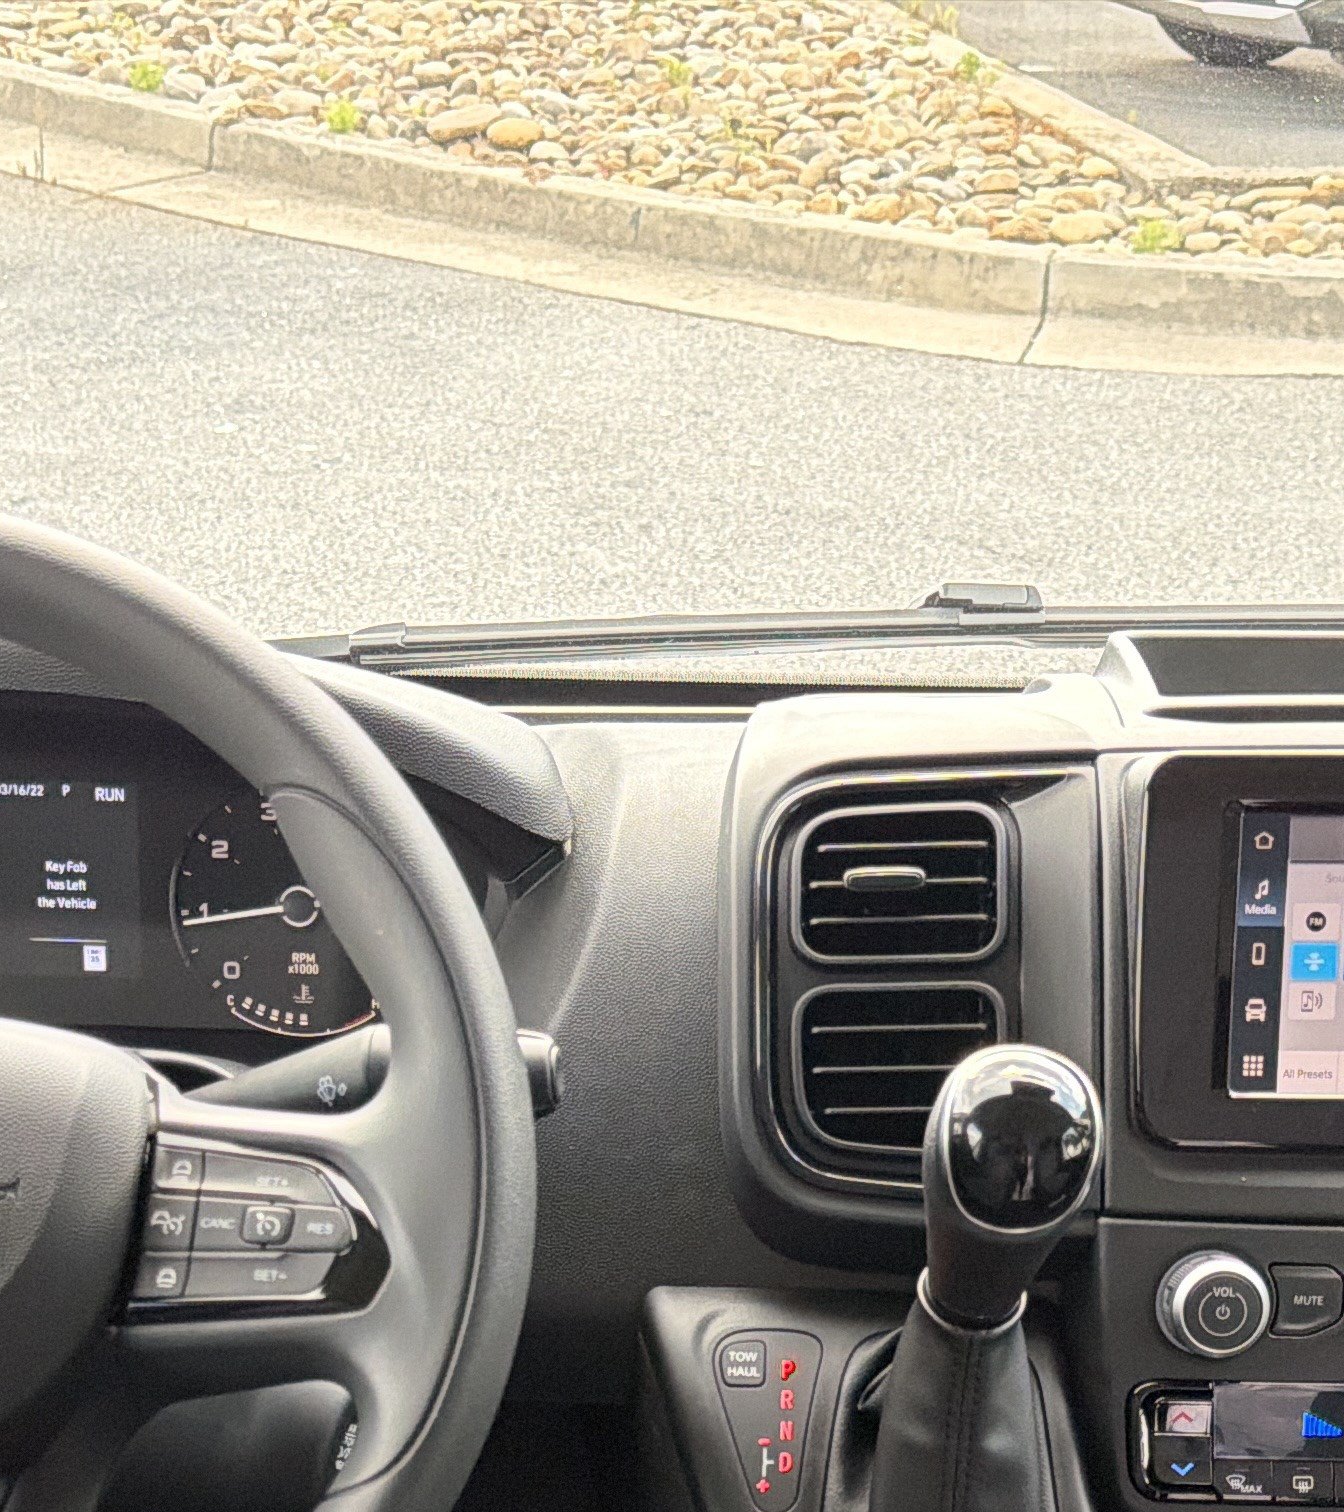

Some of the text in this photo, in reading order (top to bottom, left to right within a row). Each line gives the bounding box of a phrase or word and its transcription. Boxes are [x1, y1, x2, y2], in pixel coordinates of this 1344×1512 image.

[62, 784, 70, 797] P
[94, 787, 125, 802] RUN
[261, 802, 277, 821] 3
[211, 840, 229, 859] 2
[45, 861, 87, 874] Key Fob
[47, 878, 86, 891] has Left
[37, 897, 96, 909] the Vehicle
[1245, 904, 1276, 914] Media
[199, 902, 208, 918] 1
[1309, 917, 1323, 925] FM
[292, 952, 315, 963] RPM
[223, 961, 240, 979] 0
[288, 964, 319, 975] x1000
[226, 994, 234, 1005] C
[1283, 1069, 1332, 1079] All Presets
[1213, 1287, 1236, 1298] VOL
[1294, 1295, 1324, 1306] MUTE
[729, 1351, 758, 1363] TOW
[727, 1365, 760, 1378] HAUL
[780, 1359, 796, 1380] P
[780, 1390, 795, 1410] R
[779, 1420, 795, 1441] N
[778, 1451, 793, 1473] D
[1240, 1484, 1262, 1493] MAX
